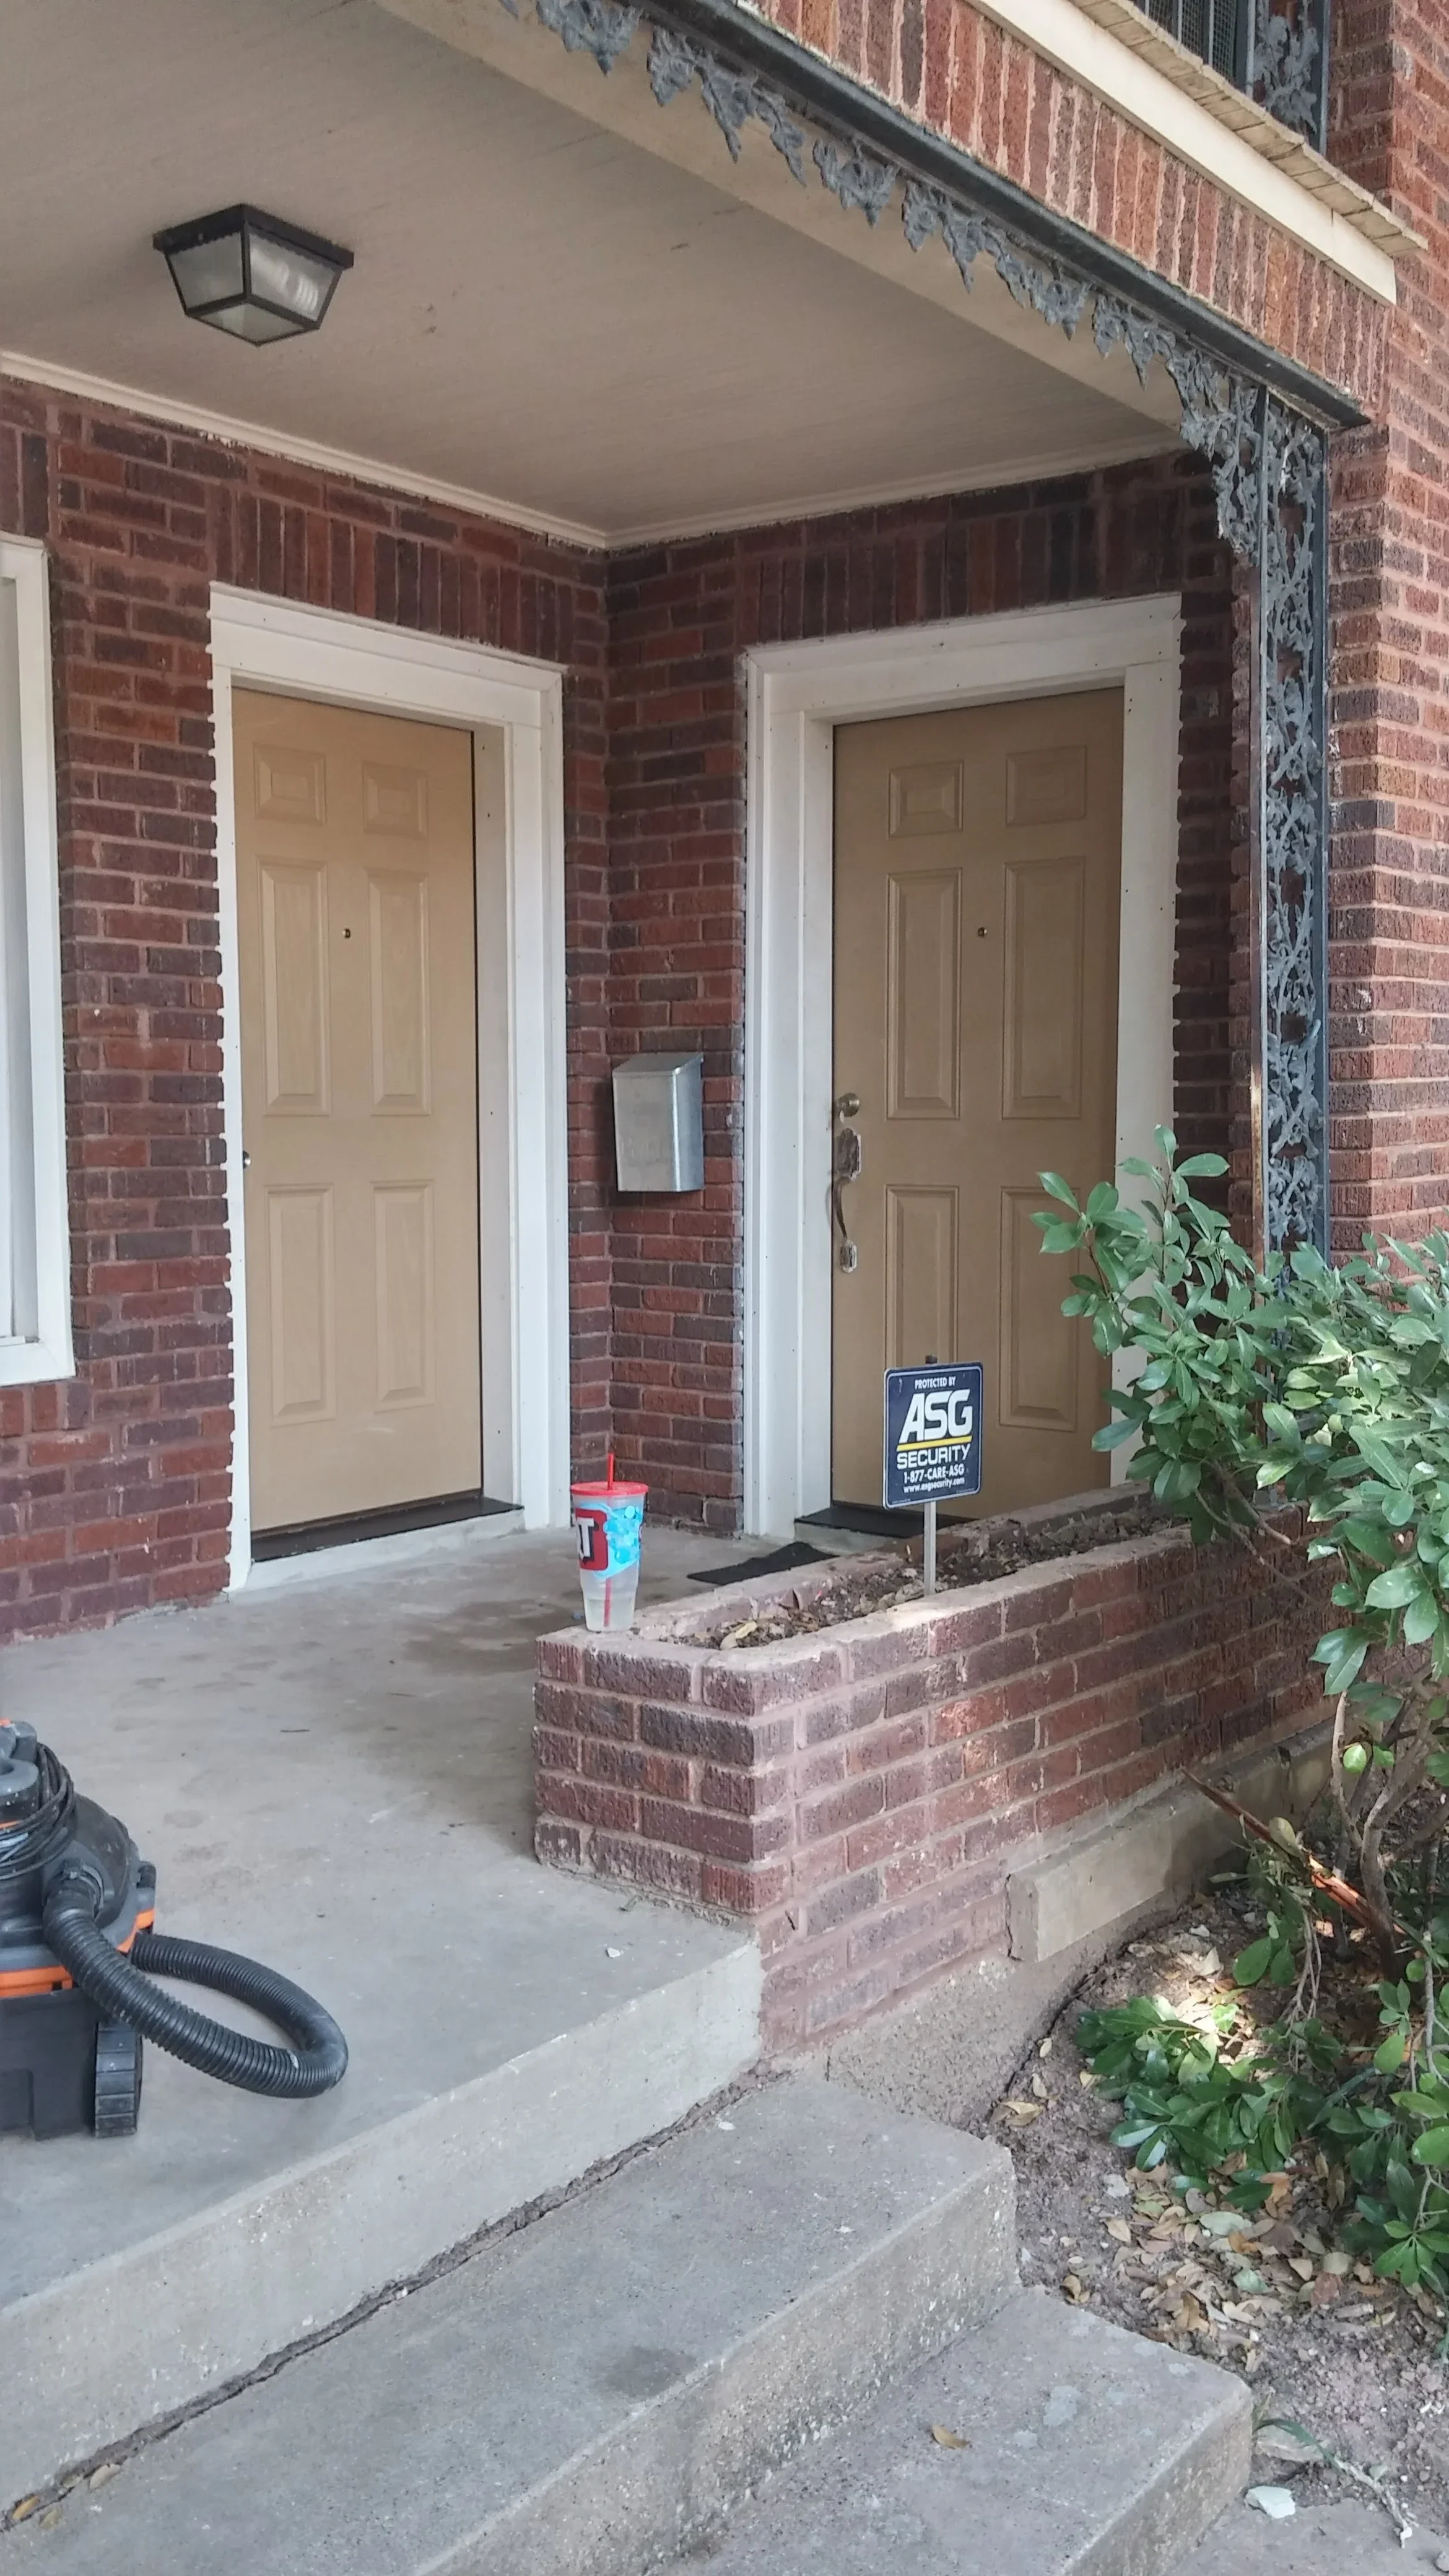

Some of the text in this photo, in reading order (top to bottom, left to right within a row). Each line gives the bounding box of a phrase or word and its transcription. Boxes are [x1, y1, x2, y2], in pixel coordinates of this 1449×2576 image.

[914, 1375, 957, 1390] PROTECTED BY
[899, 1388, 973, 1444] ASG
[897, 1443, 972, 1470] SECURITY
[903, 1463, 965, 1484] 1-877-CARE-ASG
[903, 1476, 965, 1494] www.asgsecurity.com
